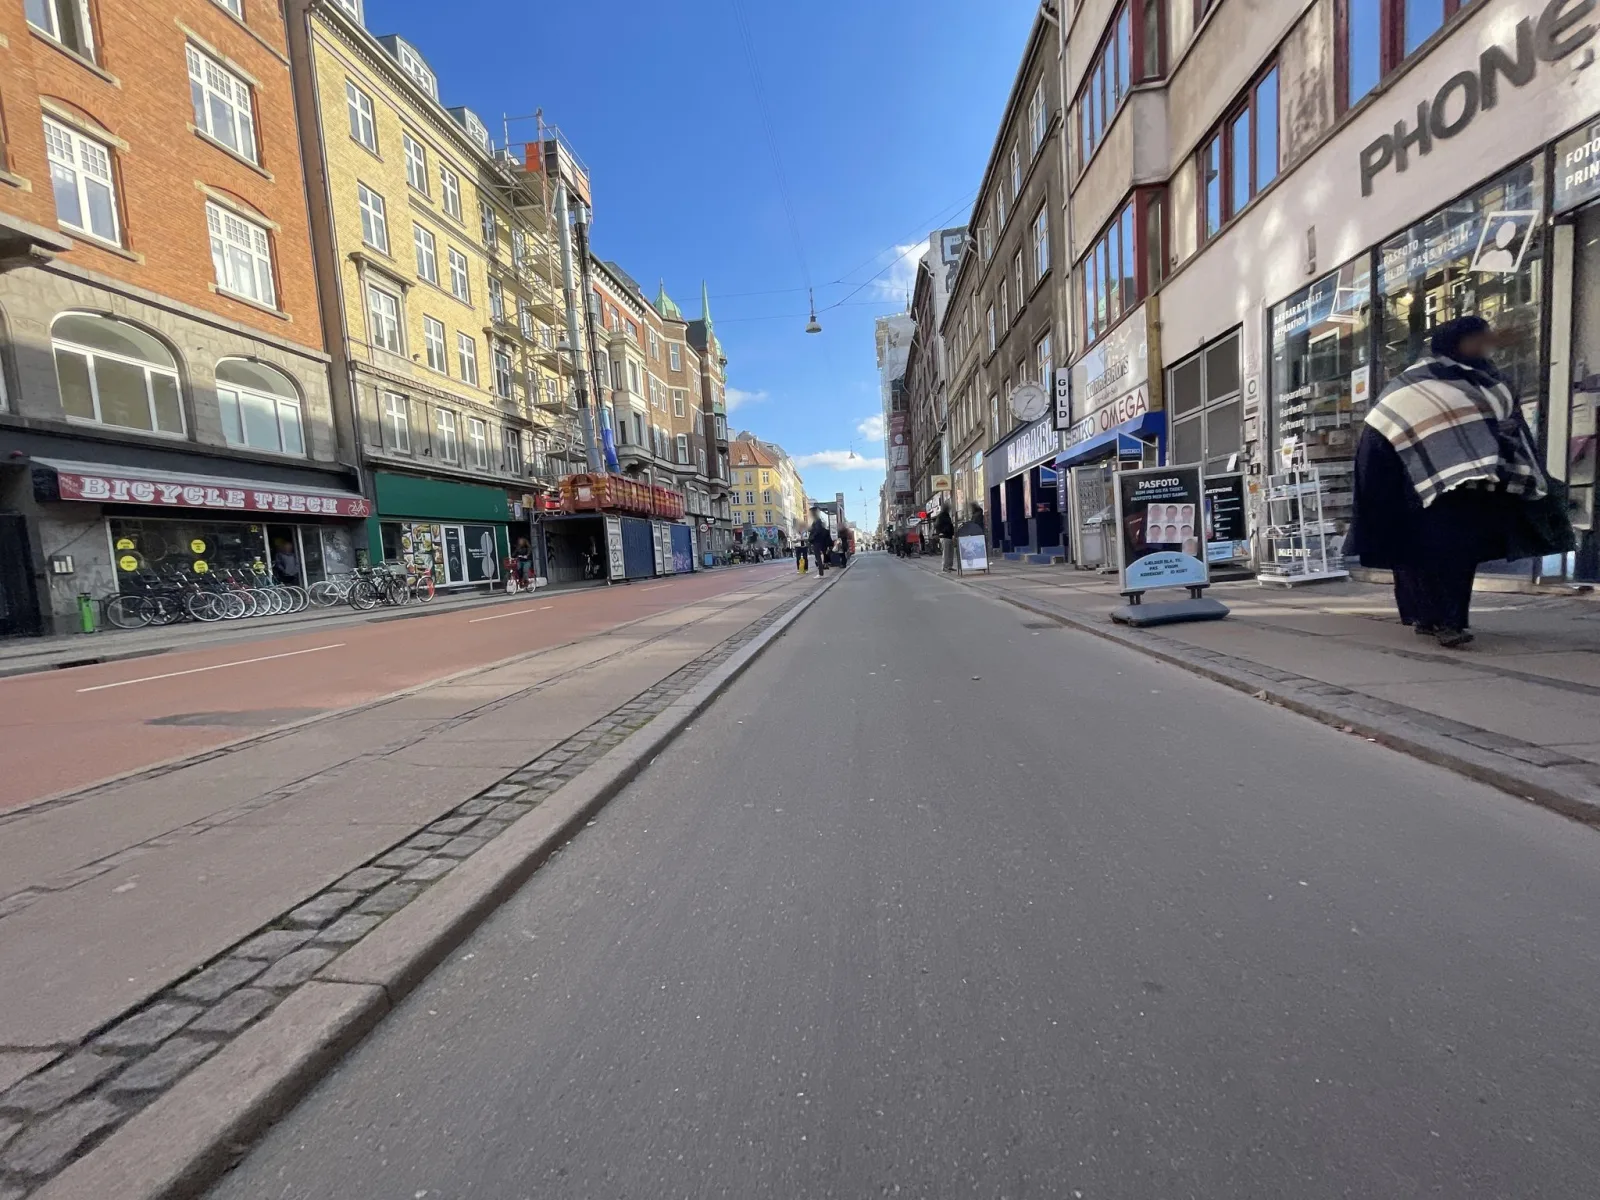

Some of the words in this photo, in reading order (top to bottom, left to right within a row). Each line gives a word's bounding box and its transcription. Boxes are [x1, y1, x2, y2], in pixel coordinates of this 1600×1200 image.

[1302, 291, 1323, 309] TALET
[1058, 379, 1067, 418] GULD
[1279, 386, 1311, 403] Reparation
[1101, 388, 1147, 431] OMEGA
[1280, 402, 1307, 418] Hardware
[1065, 416, 1096, 447] SEIKO
[1280, 418, 1305, 432] Software
[1138, 478, 1180, 490] PASFOTO
[79, 476, 245, 507] BICYCLE
[254, 491, 338, 514] TEECH
